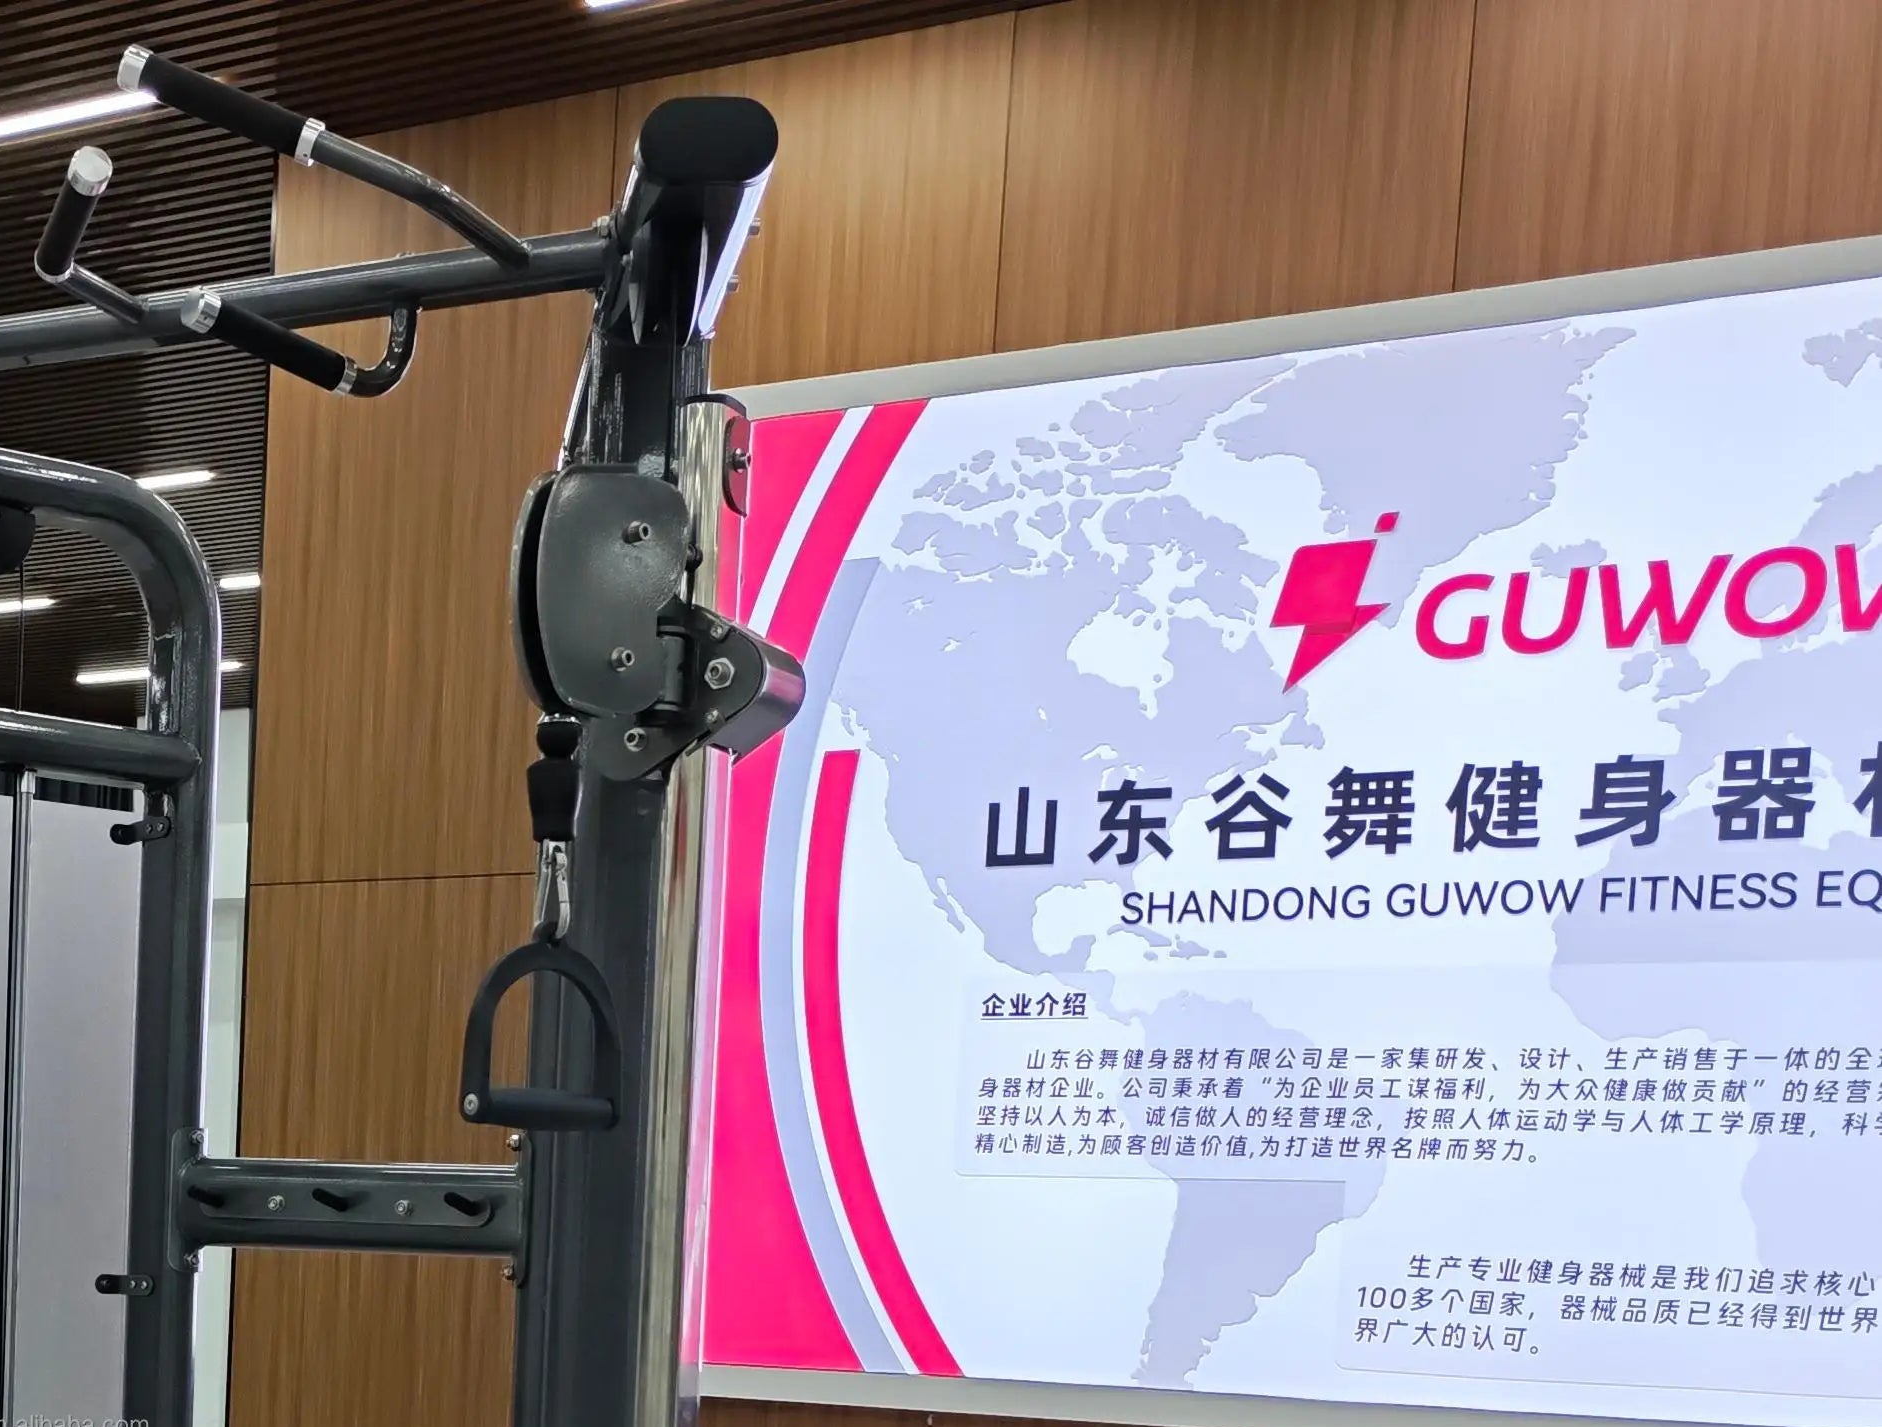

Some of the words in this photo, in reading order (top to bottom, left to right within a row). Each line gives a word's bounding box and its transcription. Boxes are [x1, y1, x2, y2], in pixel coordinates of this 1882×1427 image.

[1120, 885, 1371, 925] SHANDONG
[1386, 879, 1584, 919] GUWOW
[1599, 872, 1798, 914] FITNESS
[981, 992, 1087, 1018] 企业介绍
[1026, 1046, 1882, 1072] 山东谷舞健身器材有限公司是一家集研发、设计、生产销售于一体的全
